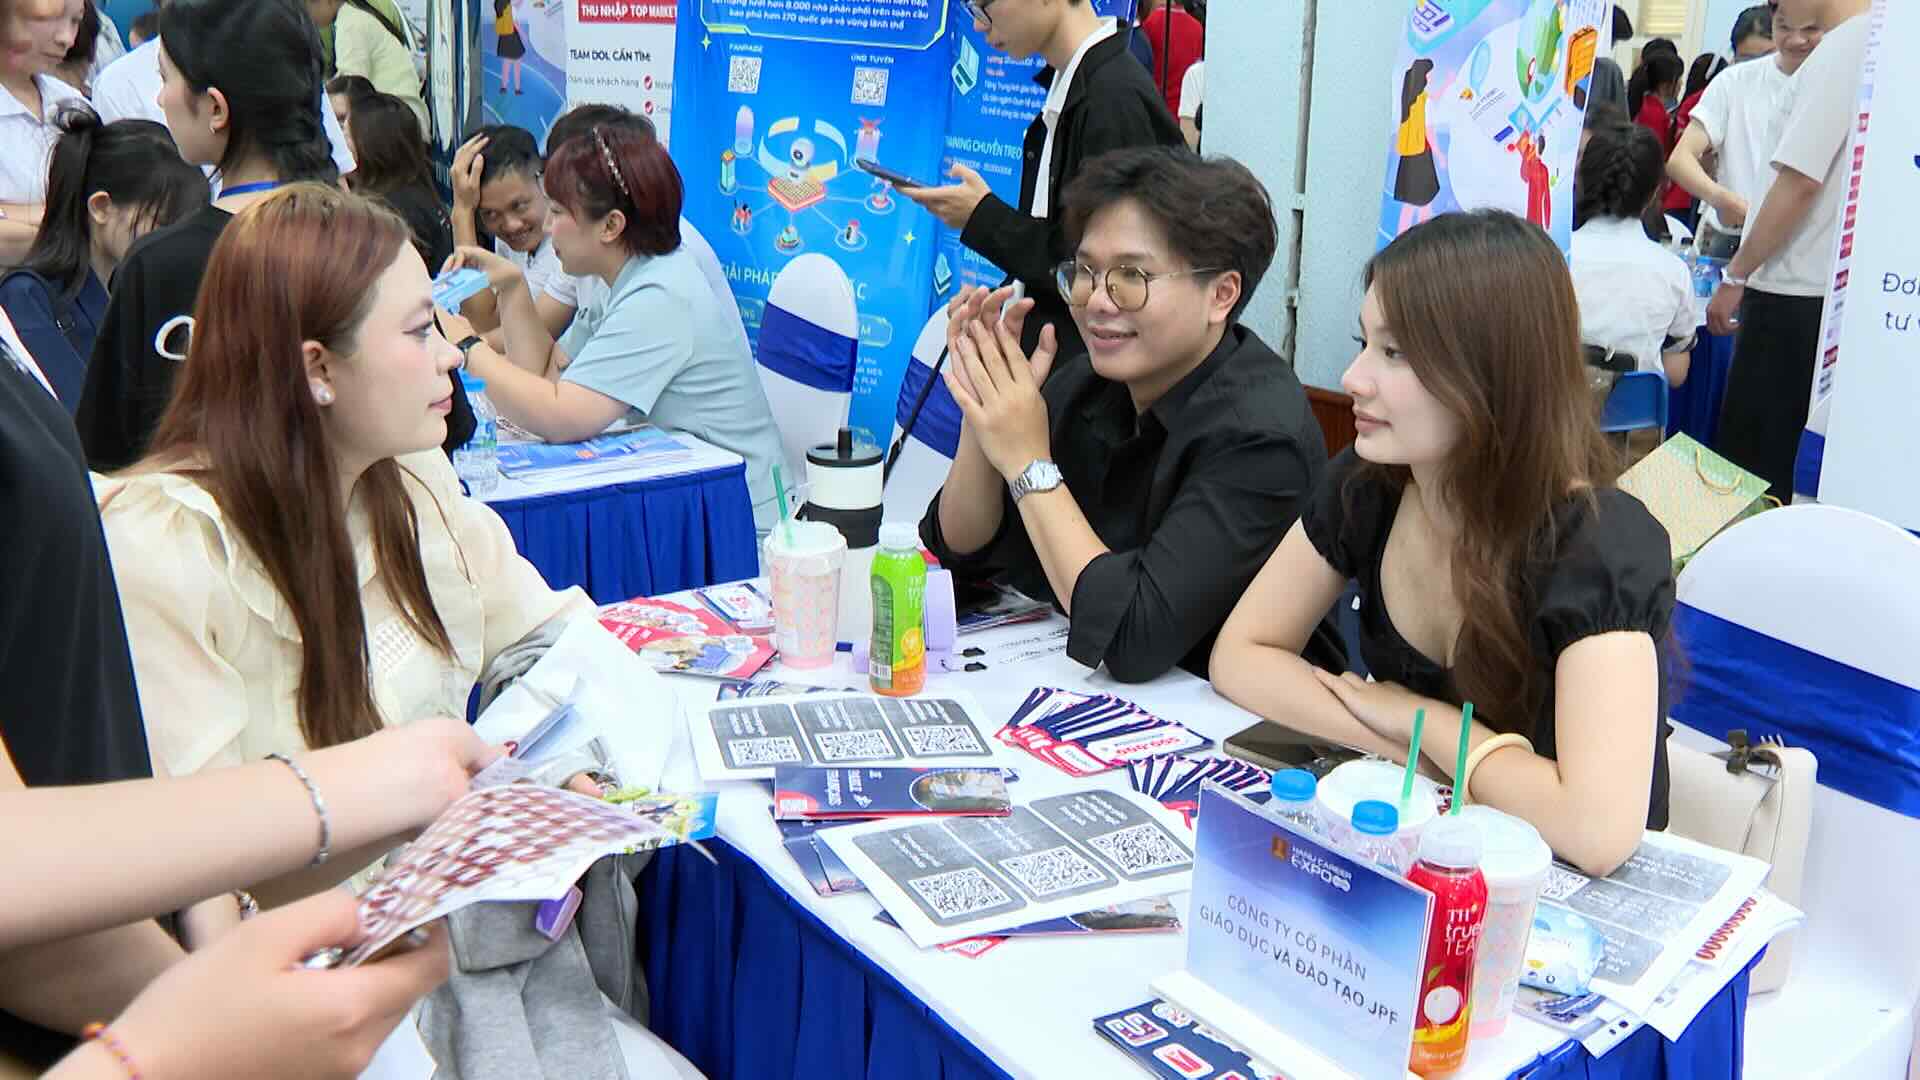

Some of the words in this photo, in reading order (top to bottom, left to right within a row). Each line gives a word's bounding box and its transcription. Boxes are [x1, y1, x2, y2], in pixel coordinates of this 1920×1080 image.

[630, 5, 648, 17] TOP
[570, 49, 591, 60] TEAM
[1882, 271, 1920, 297] Đơ
[1885, 310, 1912, 332] tư
[1227, 894, 1270, 929] CÔNG
[1274, 918, 1291, 939] TY
[1446, 922, 1481, 943] true
[1444, 938, 1475, 957] TEA
[1199, 903, 1234, 935] GIÁO
[1237, 926, 1270, 954] DỤC
[1273, 945, 1292, 968] VÀ
[1295, 958, 1329, 987] ĐÀO
[1333, 977, 1365, 1007] TẠO
[1367, 1001, 1399, 1026] JPF
